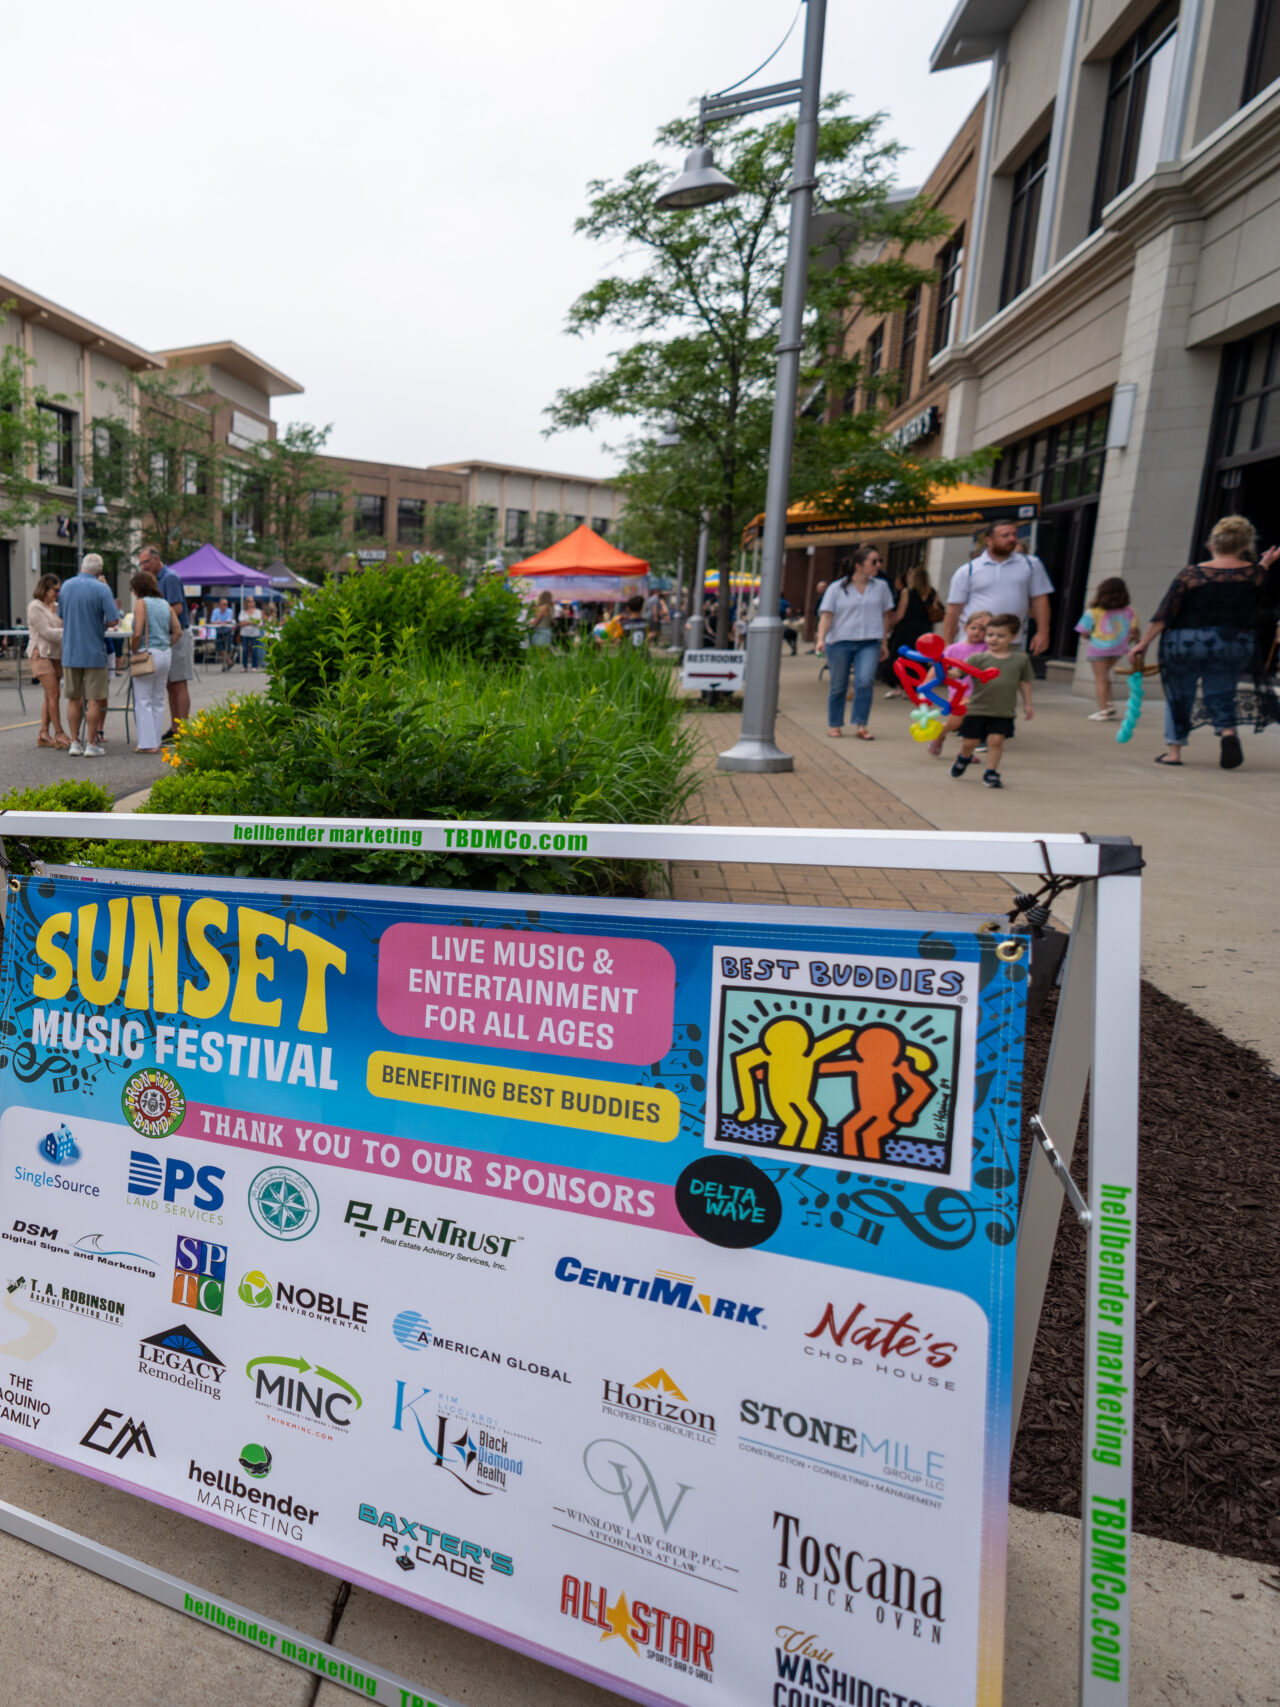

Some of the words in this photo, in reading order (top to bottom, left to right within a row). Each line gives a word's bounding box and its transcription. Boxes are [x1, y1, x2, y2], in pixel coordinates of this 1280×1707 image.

[688, 654, 743, 664] RESTROOMS
[233, 824, 325, 843] hellbender
[329, 827, 423, 846] marketing
[444, 828, 588, 851] TBDMCo.com
[32, 895, 347, 1035] SUNSET
[431, 935, 485, 964] LIVE
[493, 940, 585, 973] MUSIC
[592, 948, 615, 974] &
[721, 956, 800, 981] BEST
[808, 961, 966, 997] BUDDIES
[408, 968, 639, 1015] ENTERTAINMENT
[31, 1007, 145, 1060] MUSIC
[155, 1026, 339, 1091] FESTIVAL
[424, 1004, 476, 1035] FOR
[482, 1011, 530, 1041] ALL
[537, 1016, 615, 1051] AGES
[125, 1070, 152, 1110] IRON
[382, 1064, 497, 1099] BENEFITING
[502, 1080, 555, 1108] BEST
[560, 1091, 661, 1125] BUDDIES
[133, 1112, 169, 1136] BAND
[14, 1165, 100, 1197] SingleSource
[127, 1150, 226, 1212] DPS
[199, 1110, 283, 1147] THANK
[295, 1127, 350, 1160] YOU
[361, 1138, 401, 1168] TO
[411, 1148, 474, 1184] OUR
[485, 1162, 656, 1218] SPONSORS
[126, 1194, 159, 1211] LAND
[164, 1203, 224, 1226] SERVICES
[689, 1178, 757, 1203] DELTA
[706, 1198, 767, 1224] WAVE
[12, 1219, 59, 1241] DSM
[1, 1232, 36, 1247] Digital
[40, 1241, 70, 1255] Signs
[73, 1250, 94, 1261] and
[97, 1256, 156, 1278] Marketing
[380, 1235, 397, 1247] Real
[398, 1240, 421, 1252] Estate
[422, 1245, 456, 1260] Advisory
[456, 1253, 491, 1268] Services,
[492, 1261, 507, 1271] Inc.
[1097, 1182, 1133, 1328] hellbender
[30, 1278, 41, 1293] T.
[44, 1283, 58, 1298] A.
[61, 1287, 125, 1316] ROBINSON
[105, 1313, 124, 1325] Inc.
[275, 1303, 367, 1333] ENVIRONMENTAL
[276, 1281, 369, 1325] NOBLE
[804, 1301, 958, 1369] Nate's
[138, 1344, 227, 1384] LEGACY
[417, 1331, 501, 1365] AMERICAN
[506, 1357, 573, 1384] GLOBAL
[803, 1346, 864, 1367] CHOP
[876, 1363, 957, 1392] HOUSE
[9, 1373, 34, 1392] THE
[138, 1361, 222, 1401] Remodeling
[255, 1368, 353, 1427] MINC
[438, 1392, 459, 1404] KIM
[1092, 1329, 1129, 1468] marketing
[601, 1378, 717, 1432] Horizon
[601, 1405, 657, 1428] PROPERTIES
[696, 1433, 716, 1446] LLC
[266, 1414, 334, 1441] THINKMINC.COM
[479, 1430, 508, 1455] Black
[477, 1462, 507, 1488] Realty
[478, 1446, 524, 1477] Diamond
[738, 1442, 806, 1469] CONSTRUCTION
[812, 1464, 870, 1488] CONSULTING
[875, 1484, 943, 1511] MANAGEMENT
[882, 1465, 923, 1484] GROUP
[925, 1479, 945, 1492] LLC
[188, 1459, 320, 1526] hellbender
[196, 1488, 304, 1542] MARKETING
[358, 1503, 514, 1577] BAXTER'S
[566, 1507, 624, 1536] WINSLOW
[626, 1528, 654, 1546] LAW
[702, 1554, 723, 1571] P.C.
[588, 1529, 653, 1557] ATTORNEYS
[655, 1550, 671, 1563] AT
[672, 1557, 698, 1574] LAW
[773, 1510, 946, 1623] Toscana
[1091, 1494, 1127, 1683] TBDMCo.com
[560, 1574, 613, 1632] ALL
[630, 1600, 715, 1673] STAR
[778, 1570, 854, 1614] BRICK
[876, 1605, 942, 1645] OVEN
[183, 1592, 277, 1650] hellbender
[281, 1638, 377, 1697] marketing
[775, 1624, 835, 1664] Visit
[646, 1649, 672, 1668] SPORTS
[673, 1658, 688, 1673] BAR
[688, 1665, 695, 1675] &
[695, 1669, 714, 1684] GRILL
[775, 1647, 933, 1707] WASHINGT
